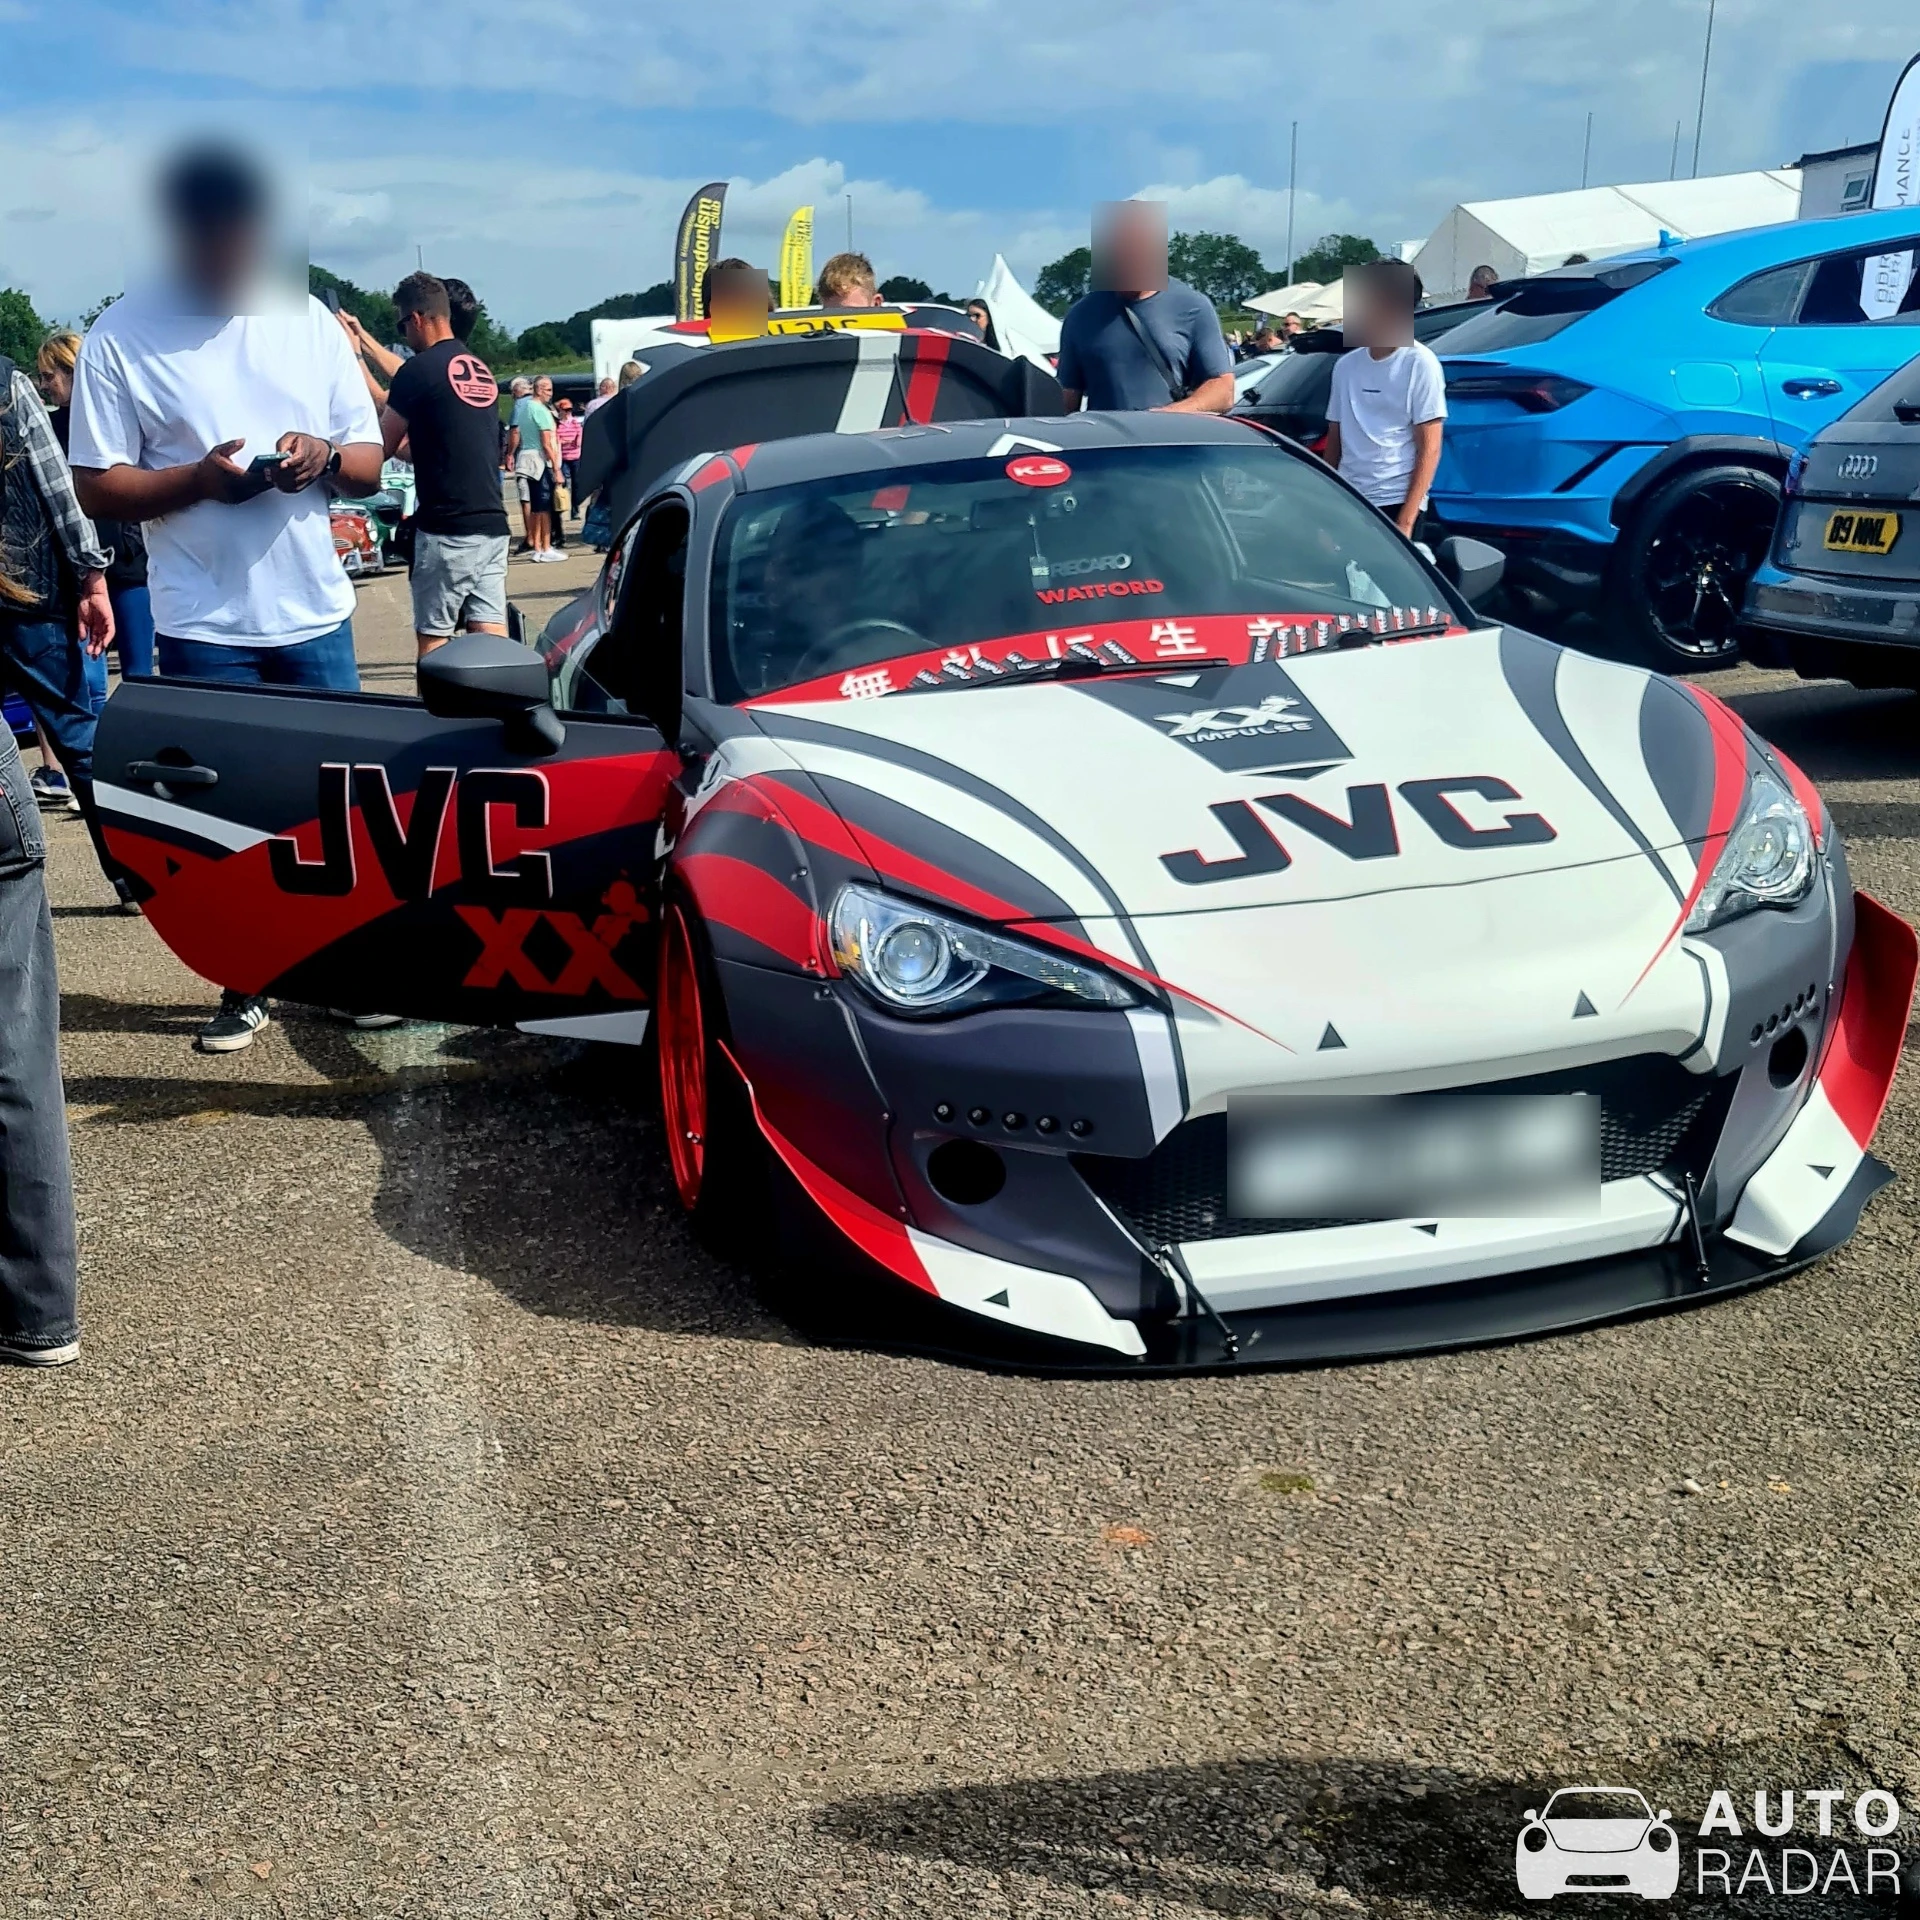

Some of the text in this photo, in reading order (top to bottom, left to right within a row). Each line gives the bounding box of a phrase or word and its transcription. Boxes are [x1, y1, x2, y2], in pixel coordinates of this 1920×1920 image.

[1050, 553, 1132, 578] RECARO
[1036, 578, 1164, 605] WATFORD
[1185, 721, 1313, 744] IMPULSE
[267, 761, 554, 898] JVC
[1158, 776, 1558, 885] JVC
